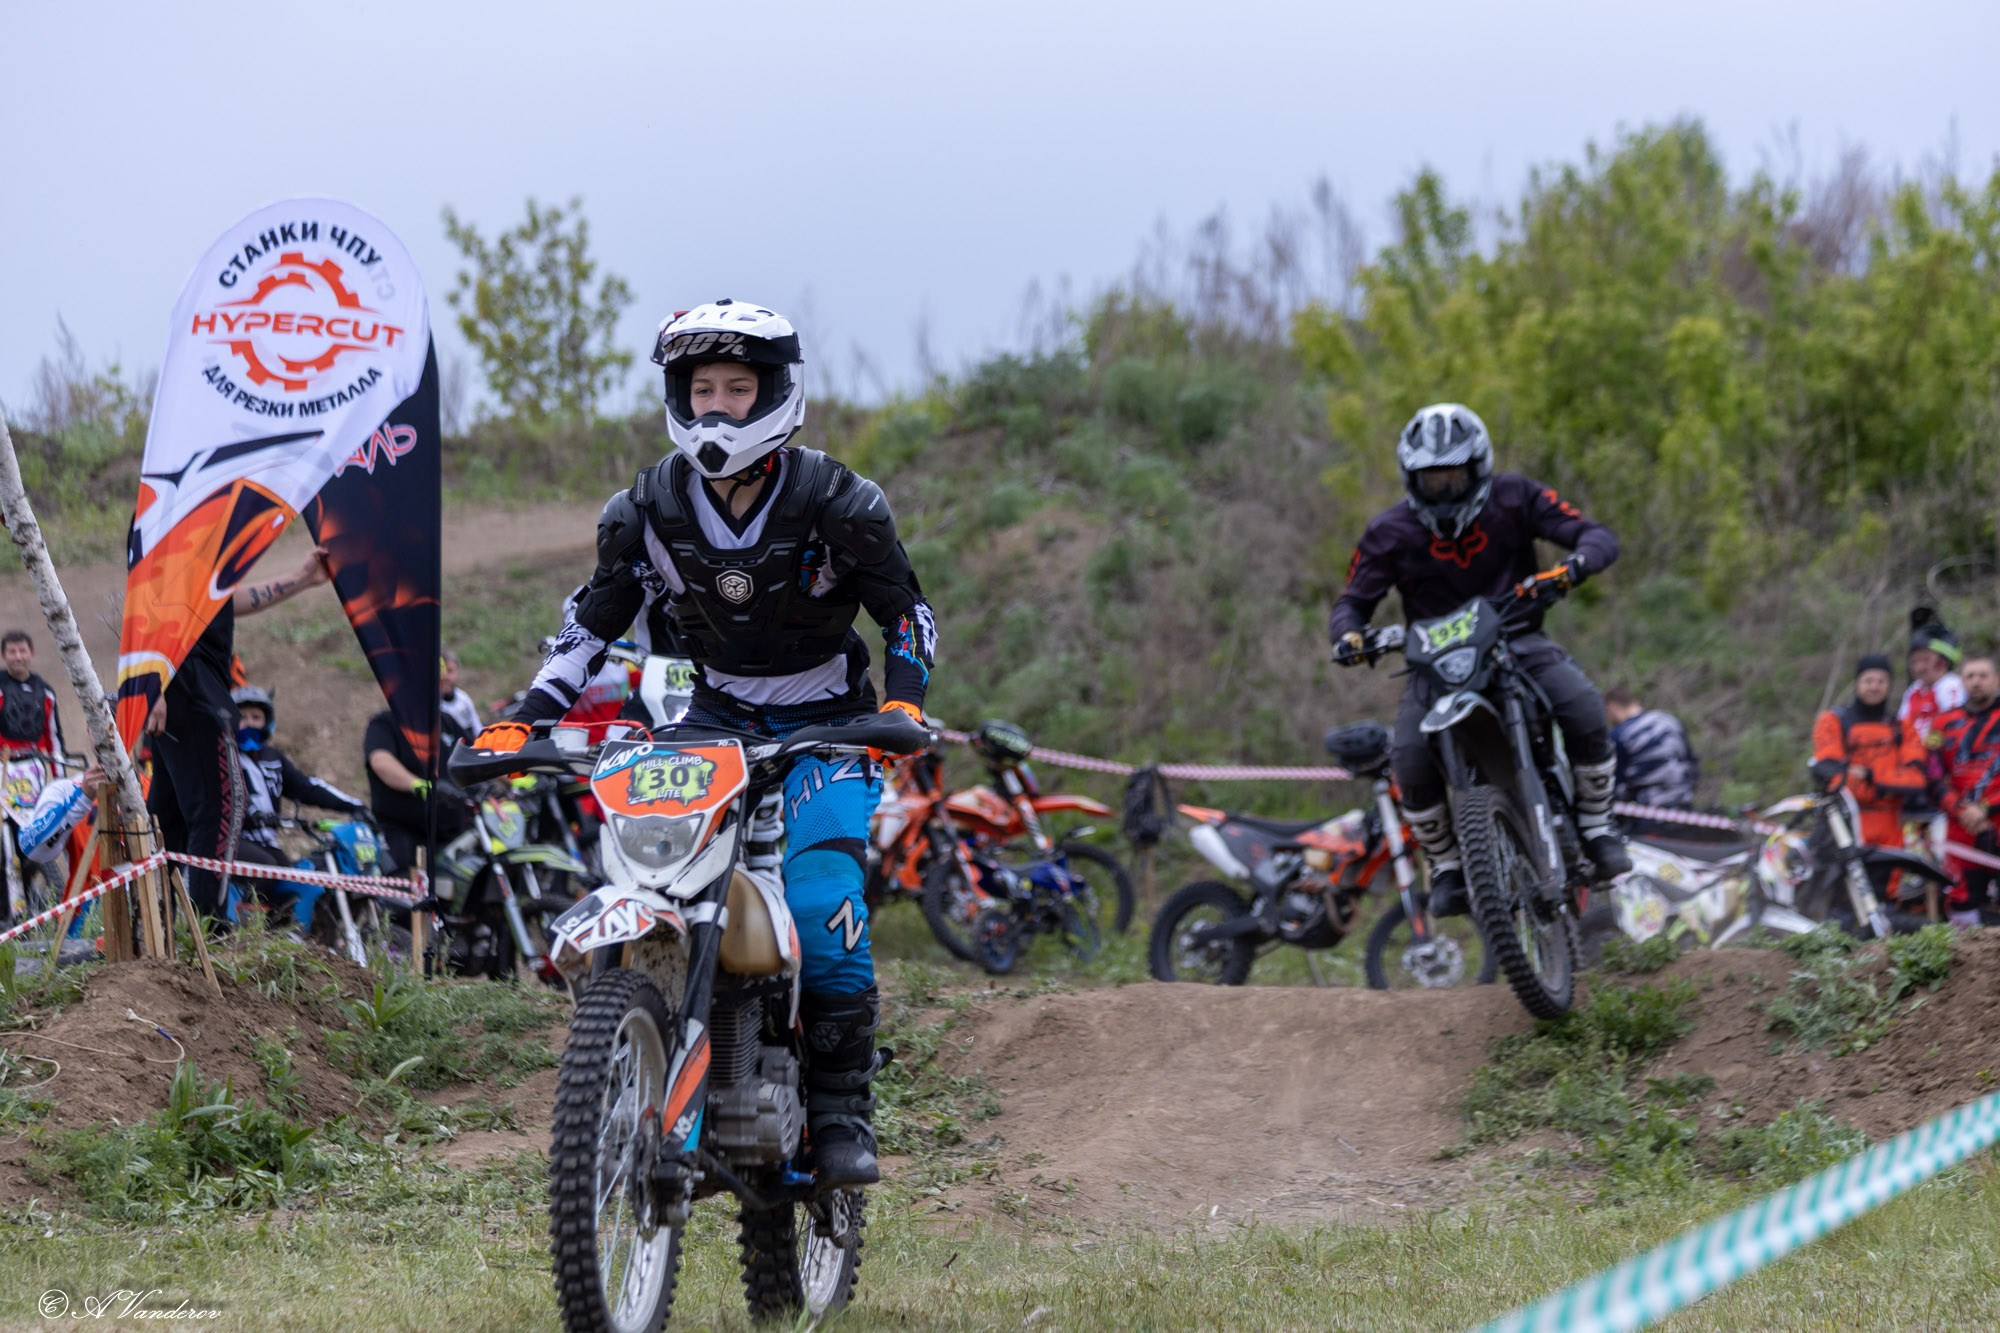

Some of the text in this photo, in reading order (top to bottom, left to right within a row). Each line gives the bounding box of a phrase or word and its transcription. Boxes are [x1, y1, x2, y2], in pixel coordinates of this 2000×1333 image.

[218, 221, 382, 289] СТАНКИ ЧПУ
[191, 312, 405, 349] HYPERCUT
[202, 364, 382, 418] ДЛЯ РЕЗКИ МЕТАЛЛА
[596, 743, 654, 775] KAYO
[641, 755, 703, 770] HILL CLIMB
[648, 766, 690, 790] 30
[657, 788, 682, 800] LITE
